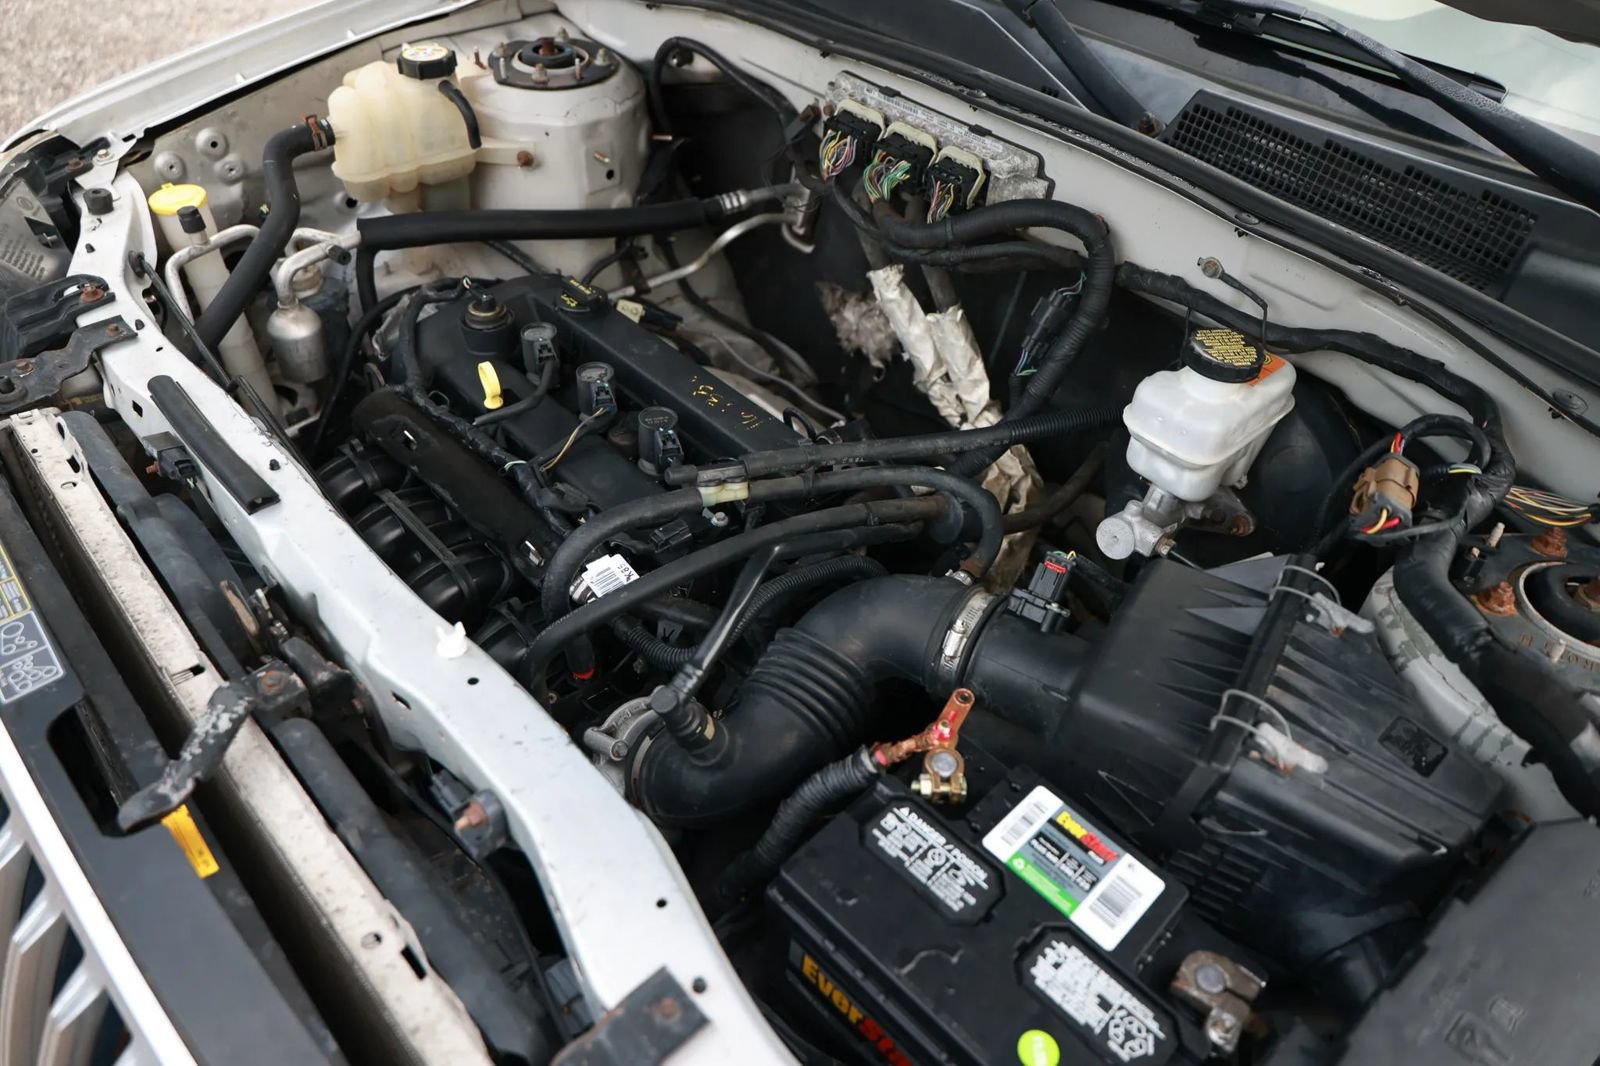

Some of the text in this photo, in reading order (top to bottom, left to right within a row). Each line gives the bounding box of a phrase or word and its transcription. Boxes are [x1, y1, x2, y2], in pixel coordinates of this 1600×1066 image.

[908, 812, 947, 846] DANGER
[951, 848, 988, 881] POISON
[1056, 810, 1119, 862] EverStart
